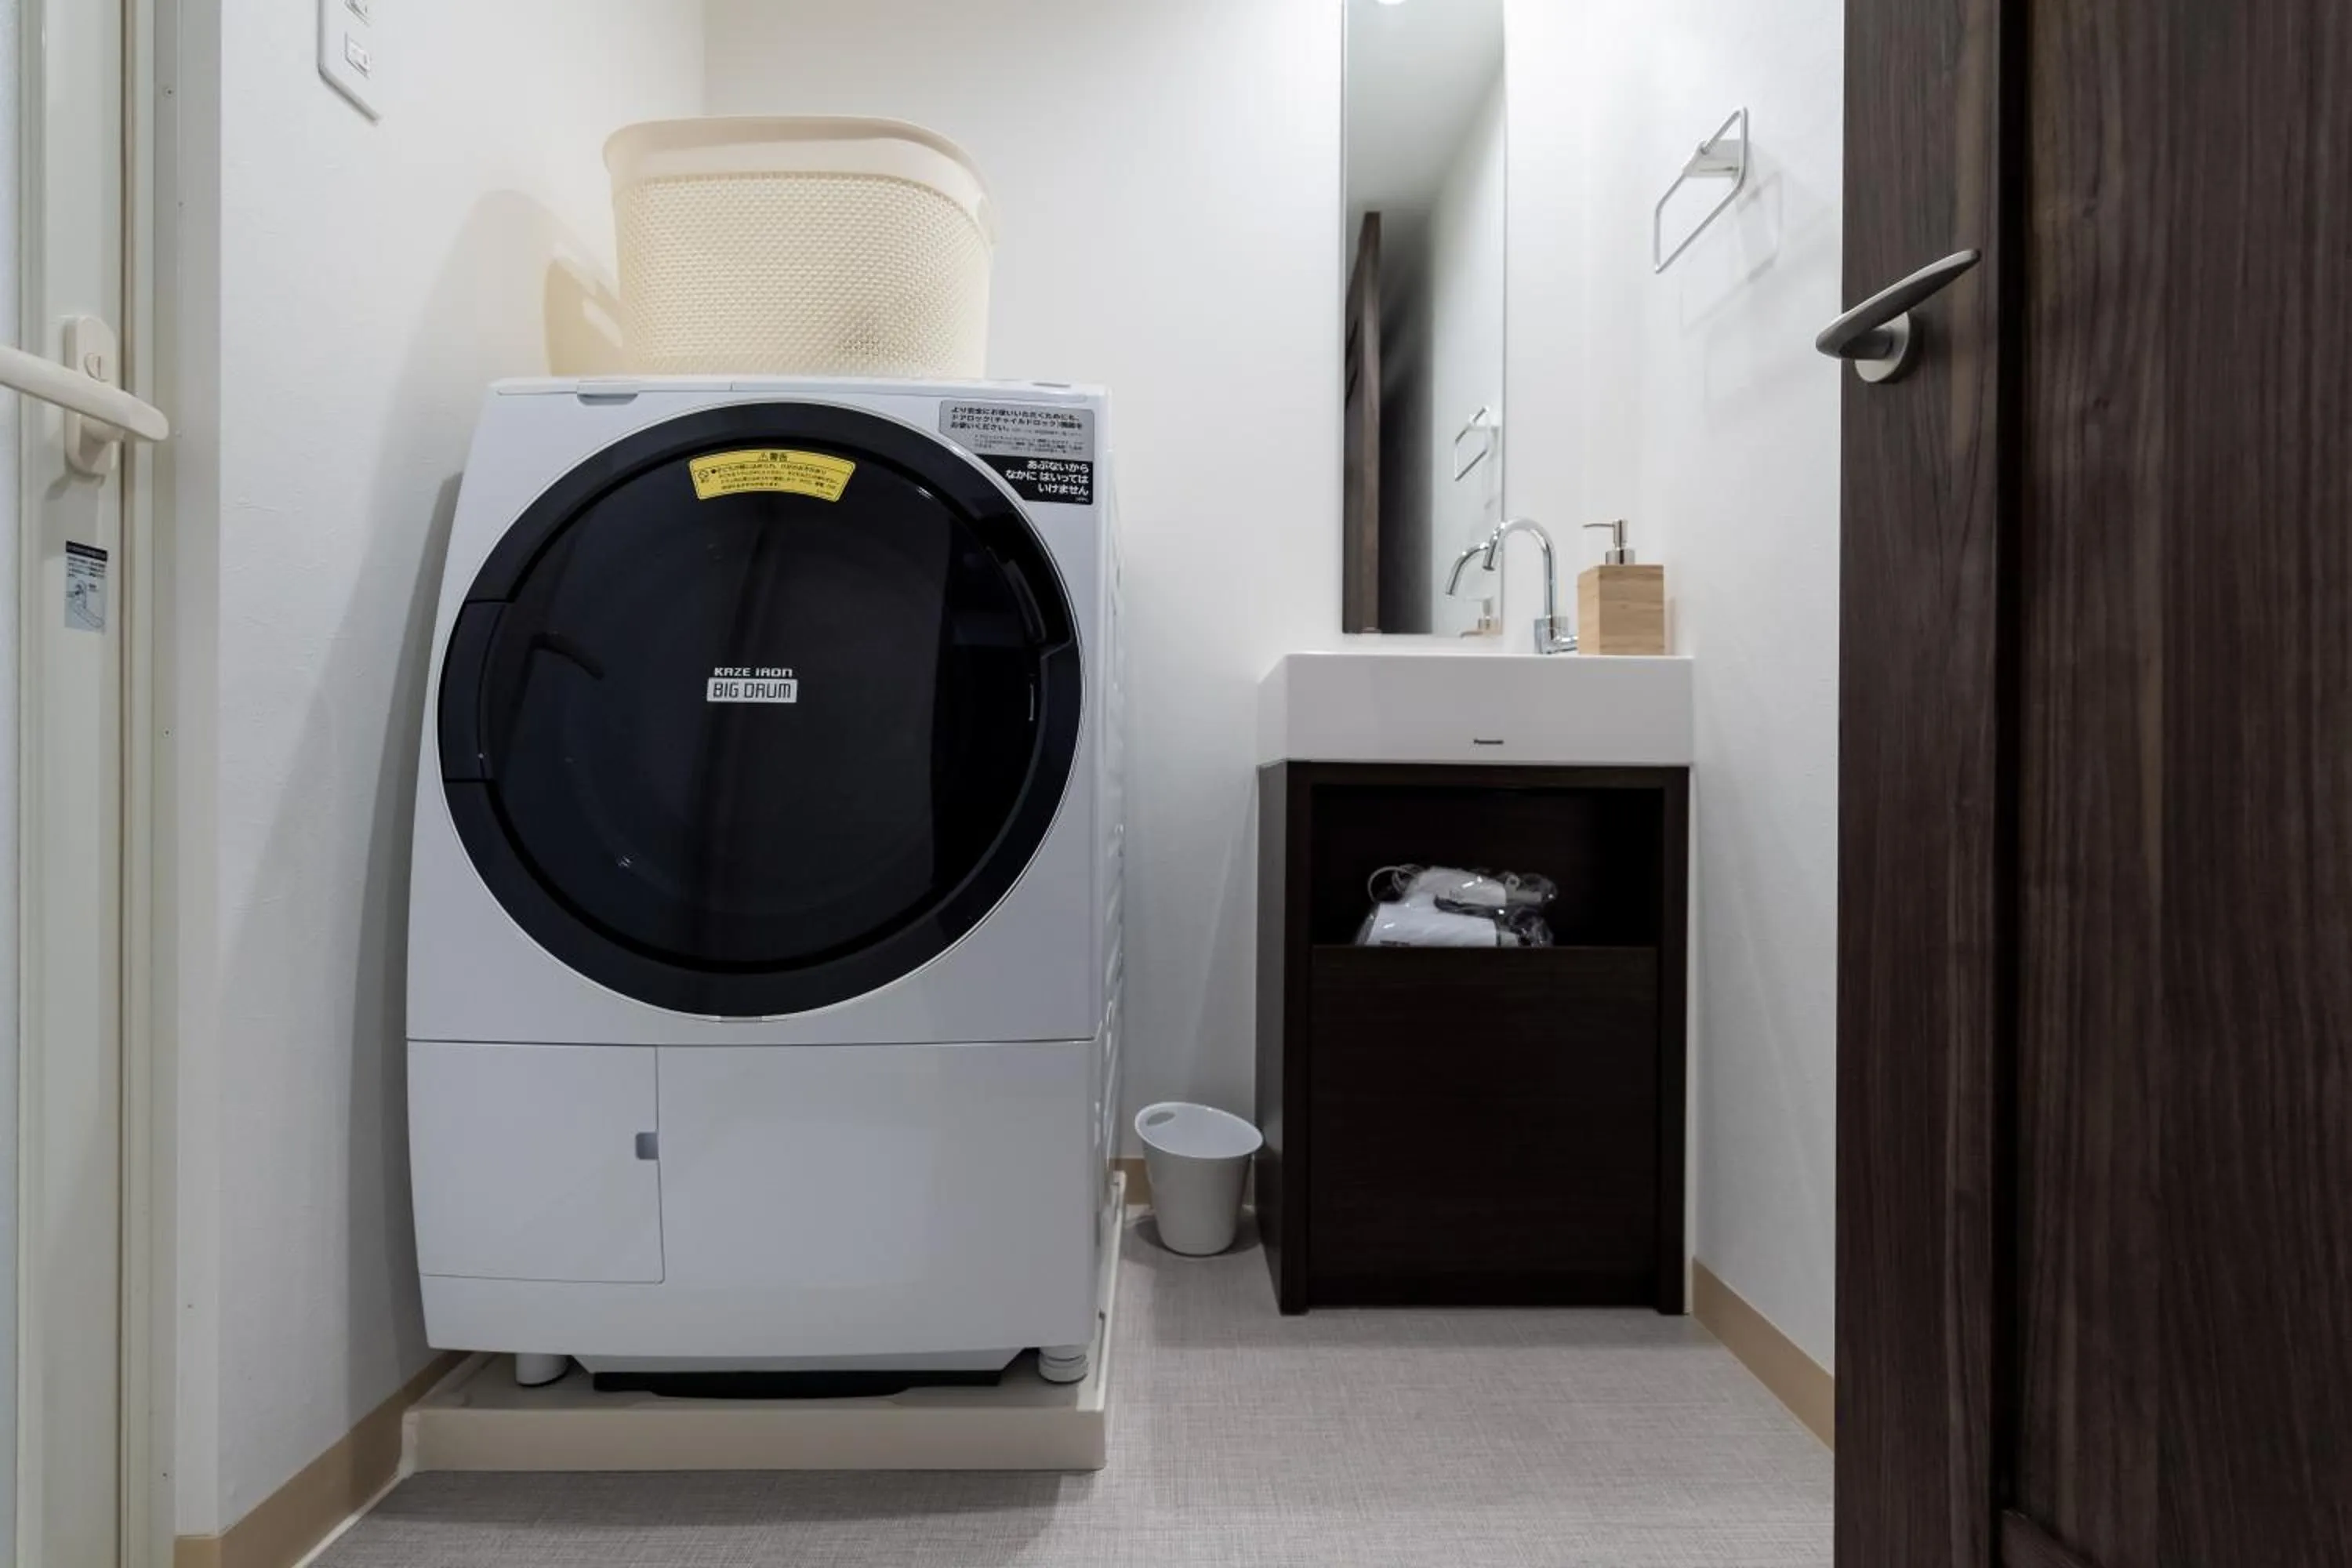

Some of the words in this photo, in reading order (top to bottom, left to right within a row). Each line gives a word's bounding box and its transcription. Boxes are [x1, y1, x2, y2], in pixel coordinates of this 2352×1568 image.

[1027, 460, 1089, 473] あぶないから
[1038, 483, 1089, 496] いけません
[714, 667, 751, 677] KAZE
[755, 667, 793, 677] IRON
[713, 683, 739, 699] BIG
[744, 683, 791, 699] DRUM
